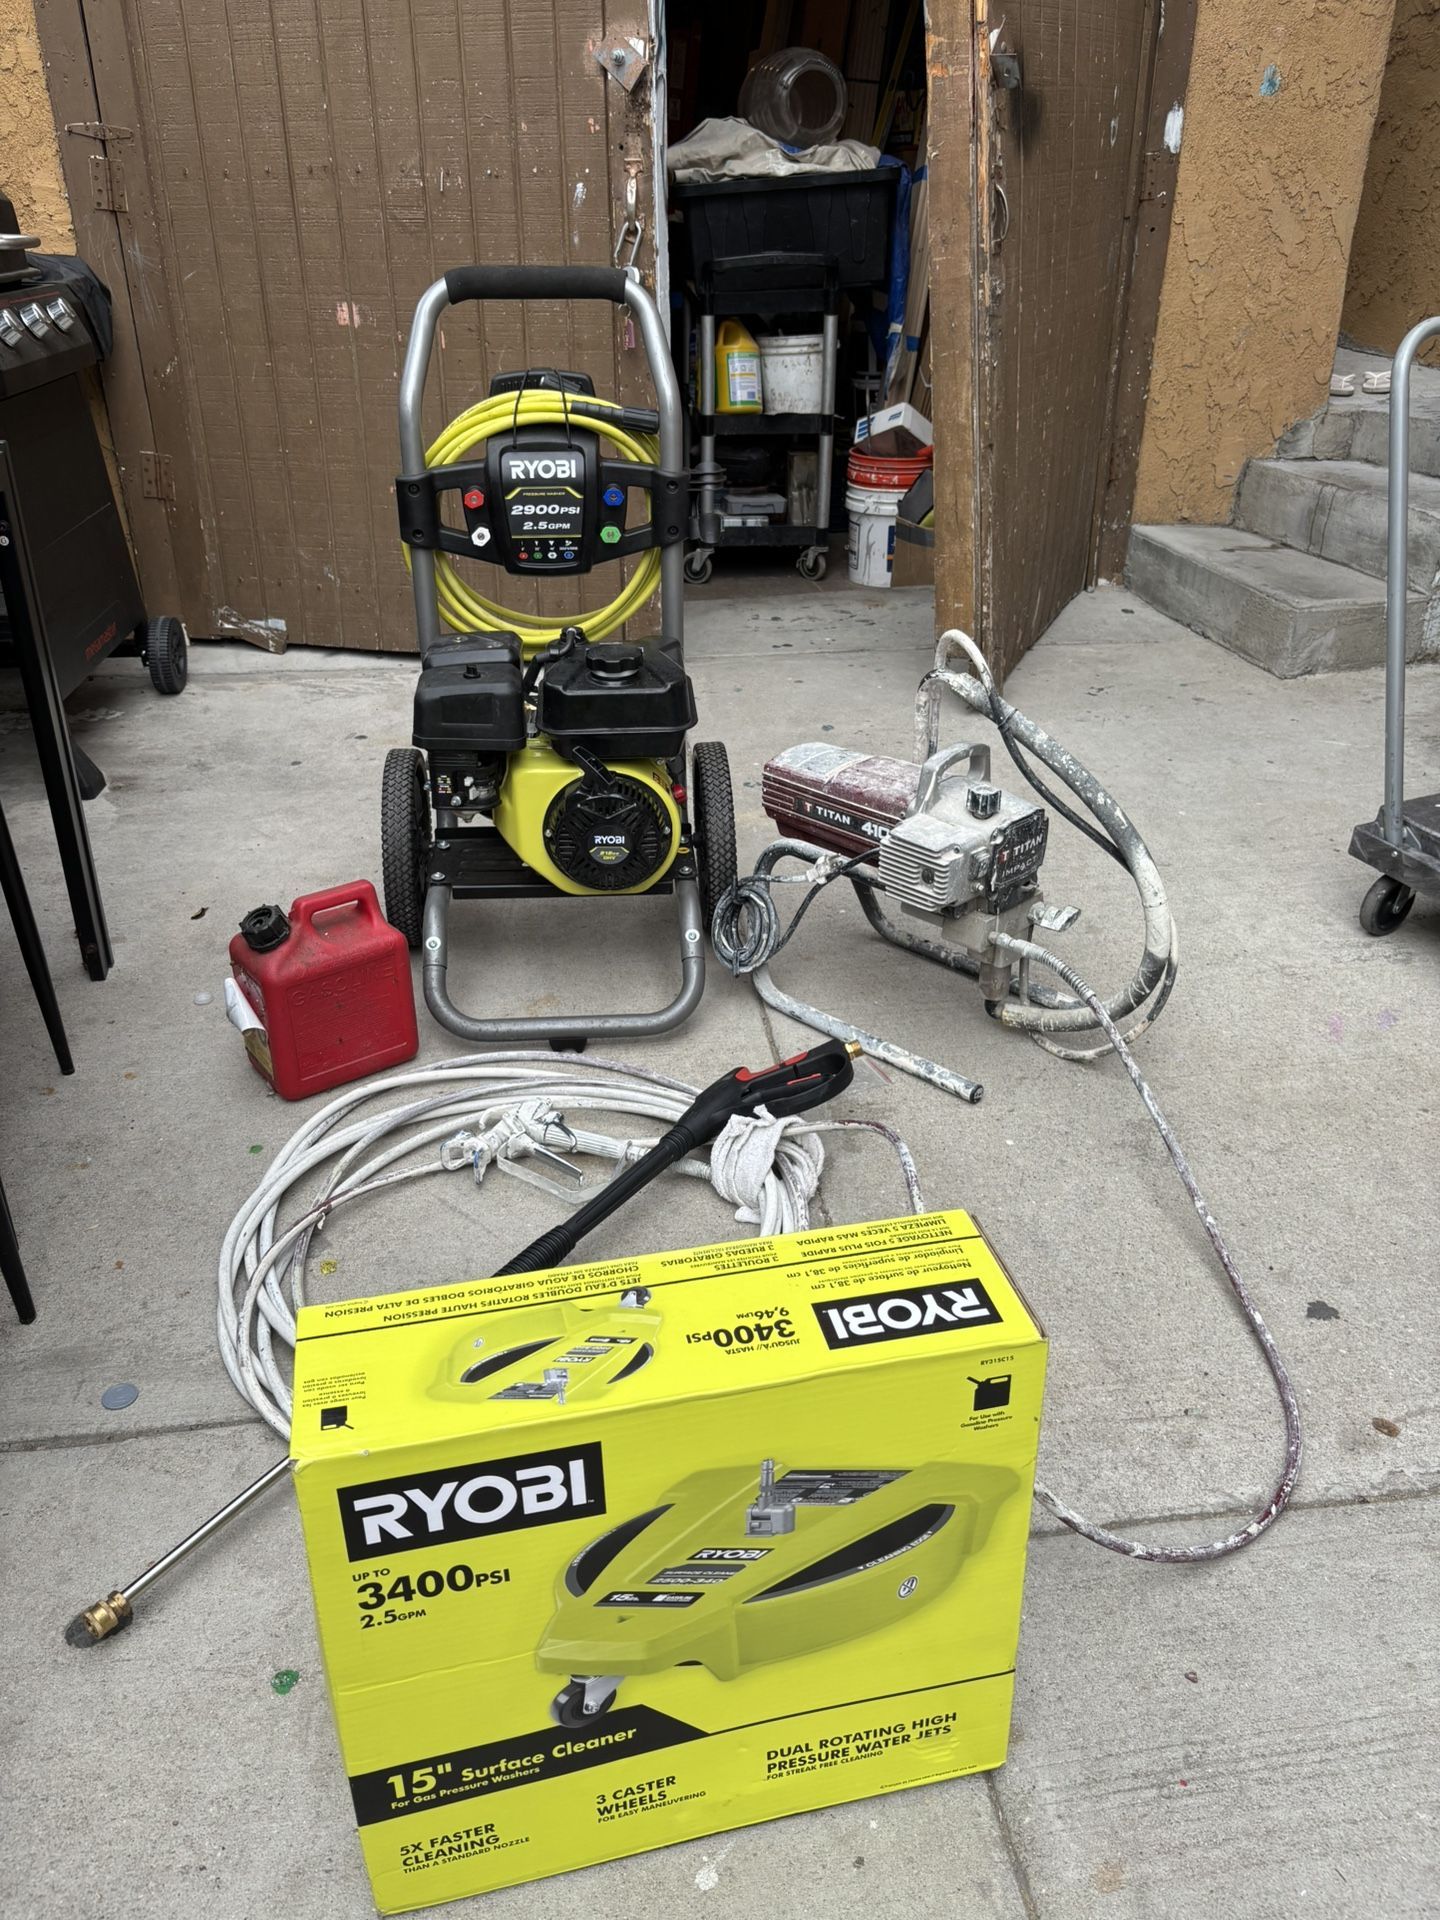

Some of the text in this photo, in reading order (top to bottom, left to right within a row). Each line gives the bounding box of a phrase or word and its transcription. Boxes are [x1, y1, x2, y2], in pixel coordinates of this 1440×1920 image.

[509, 459, 576, 479] RYOBI
[816, 805, 850, 825] TITAN
[594, 835, 625, 845] RYOBI
[1014, 834, 1043, 856] TITAN
[899, 1218, 946, 1230] LIMPIEZA
[859, 1227, 891, 1236] VECES
[895, 1229, 953, 1242] NETTOYAGE
[837, 1242, 863, 1251] PLUS
[863, 1239, 887, 1247] FOIS
[724, 1245, 766, 1257] RUEDAS
[799, 1246, 837, 1257] RAPIDE
[911, 1246, 964, 1260] Limpiador
[659, 1252, 723, 1267] GIRATORIAS
[713, 1257, 770, 1271] ROULETTES
[841, 1256, 897, 1271] superficies
[920, 1259, 972, 1274] Nettoyeur
[587, 1265, 639, 1278] CHORROS
[803, 1267, 826, 1277] 38,1
[826, 1265, 842, 1273] de
[536, 1275, 569, 1286] AGUA
[570, 1273, 585, 1281] DE
[827, 1278, 851, 1288] 38,1
[851, 1276, 867, 1285] de
[866, 1271, 905, 1283] surface
[382, 1276, 642, 1322] JETS D'EAU DOUBLES ROTATIFS HAUTE PRESSION
[404, 1297, 419, 1306] DE
[422, 1291, 464, 1303] DOBLES
[375, 1300, 402, 1310] ALTA
[825, 1285, 991, 1340] RYOBI
[724, 1344, 755, 1355] HASTA
[352, 1458, 588, 1546] RYOBI
[695, 1549, 768, 1560] RYOBI
[351, 1567, 390, 1582] UP TO
[766, 1711, 957, 1762] DUAL ROTATING HIGH
[767, 1723, 951, 1774] PRESSURE WATER JETS
[385, 1726, 637, 1800] 15" Surface Cleaner
[766, 1749, 883, 1781] FOR STREAK FREE CLEANING
[390, 1765, 540, 1810] For Gas Pressure Washers
[595, 1774, 676, 1805] 3 CASTER
[596, 1789, 667, 1817] WHEELS
[597, 1790, 706, 1823] FOR EASY MANEUVERING
[398, 1822, 496, 1856] 5X FASTER
[400, 1833, 500, 1868] CLEANING
[402, 1836, 530, 1874] THAN A STANDARD NOZZLE
